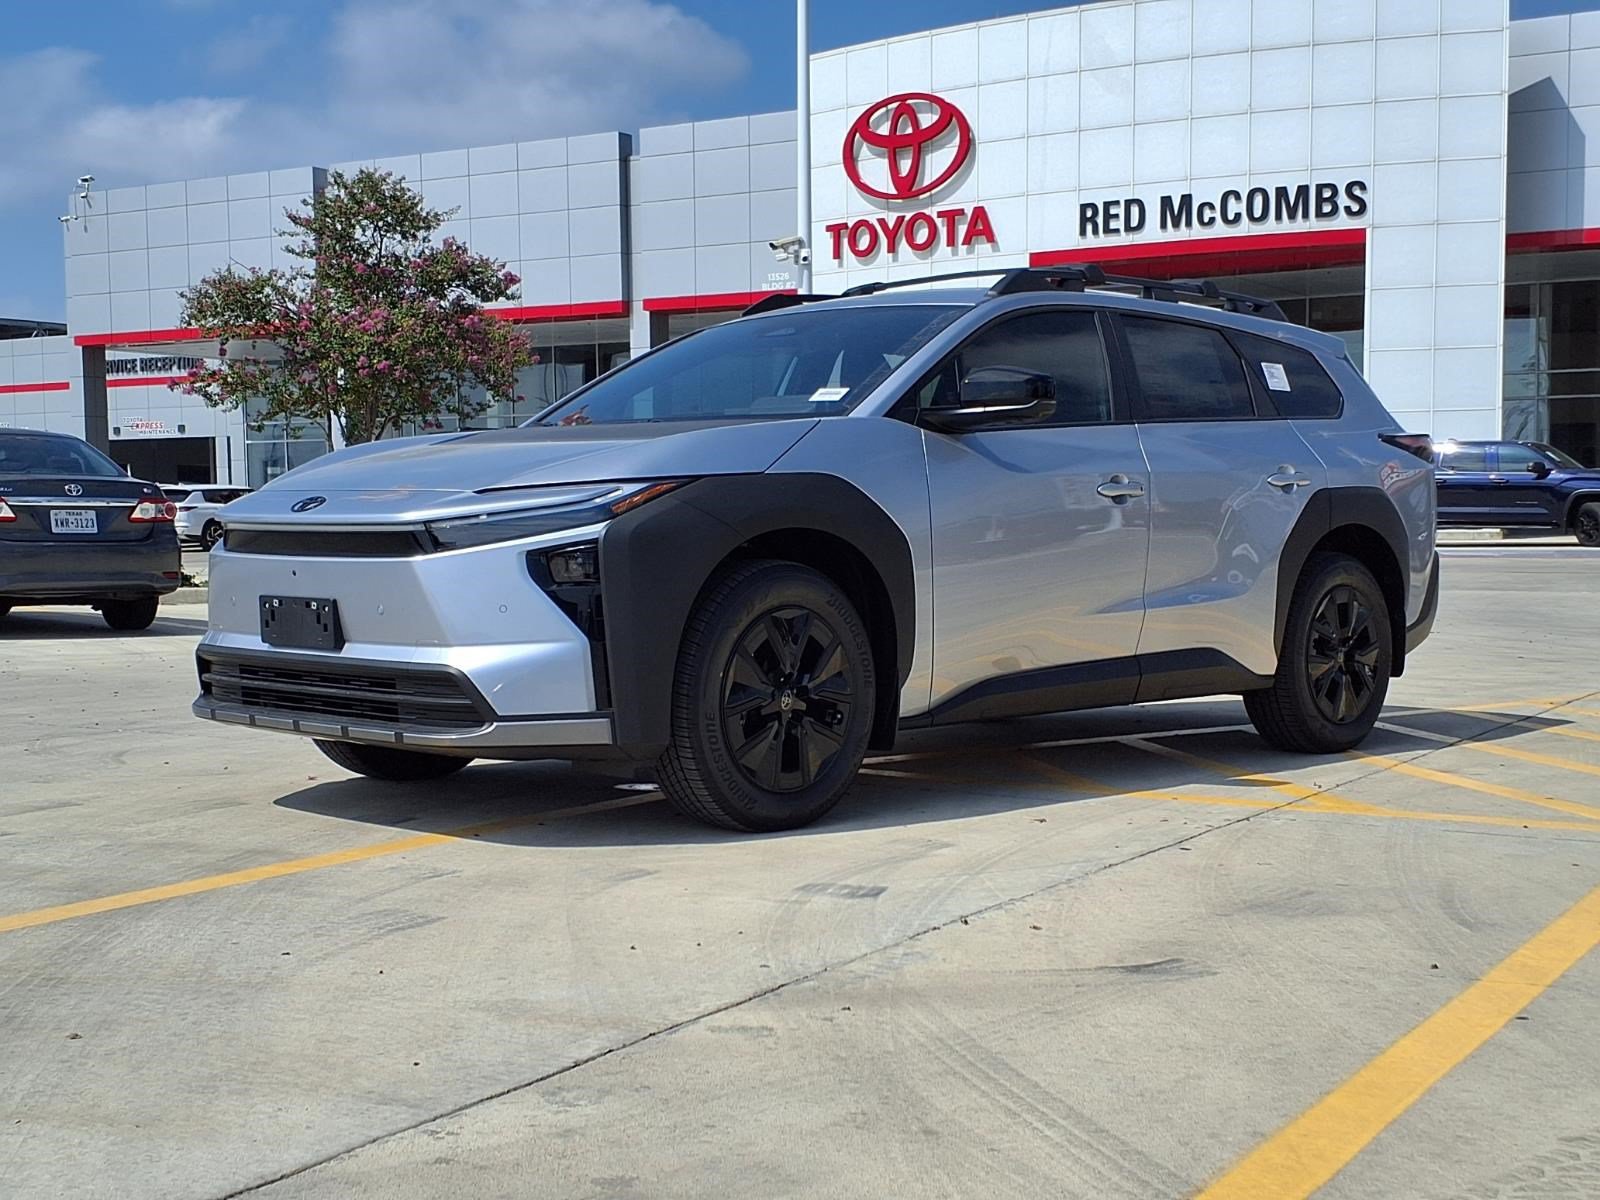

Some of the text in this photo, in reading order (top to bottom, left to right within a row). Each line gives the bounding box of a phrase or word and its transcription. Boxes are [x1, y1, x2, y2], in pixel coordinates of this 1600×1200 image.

[825, 206, 996, 260] TOYOTA
[1079, 180, 1367, 237] RED McCOMBS
[131, 422, 164, 430] EXPRESS
